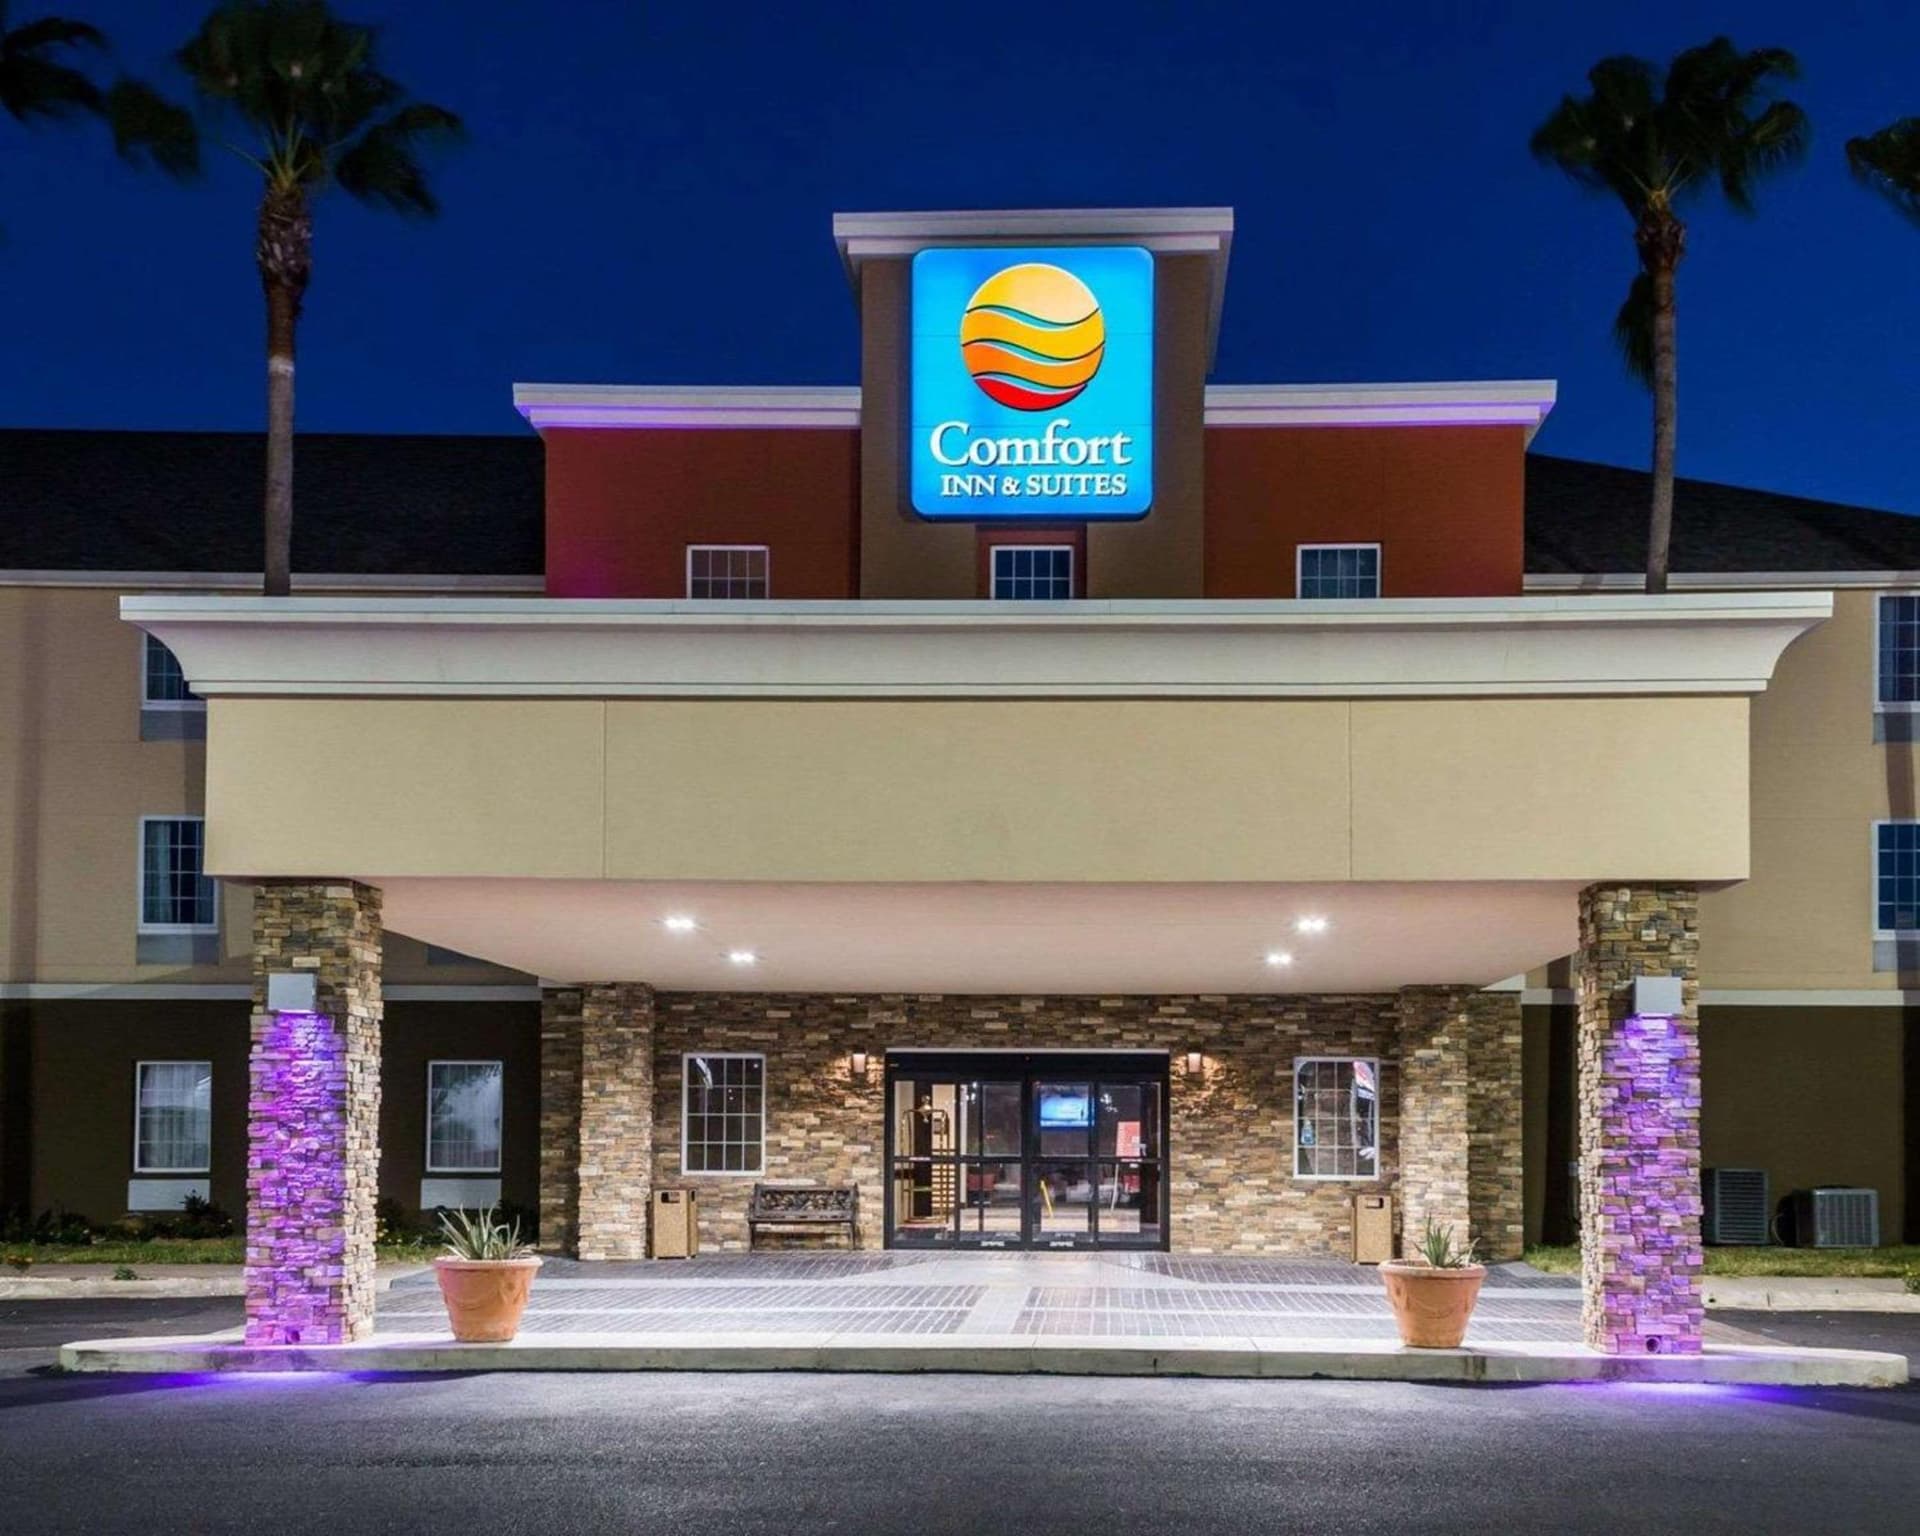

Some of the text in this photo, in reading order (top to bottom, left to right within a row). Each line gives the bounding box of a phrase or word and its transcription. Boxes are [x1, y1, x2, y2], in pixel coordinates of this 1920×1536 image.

[930, 418, 1132, 466] Comfort
[940, 473, 1128, 496] INN & SUITES
